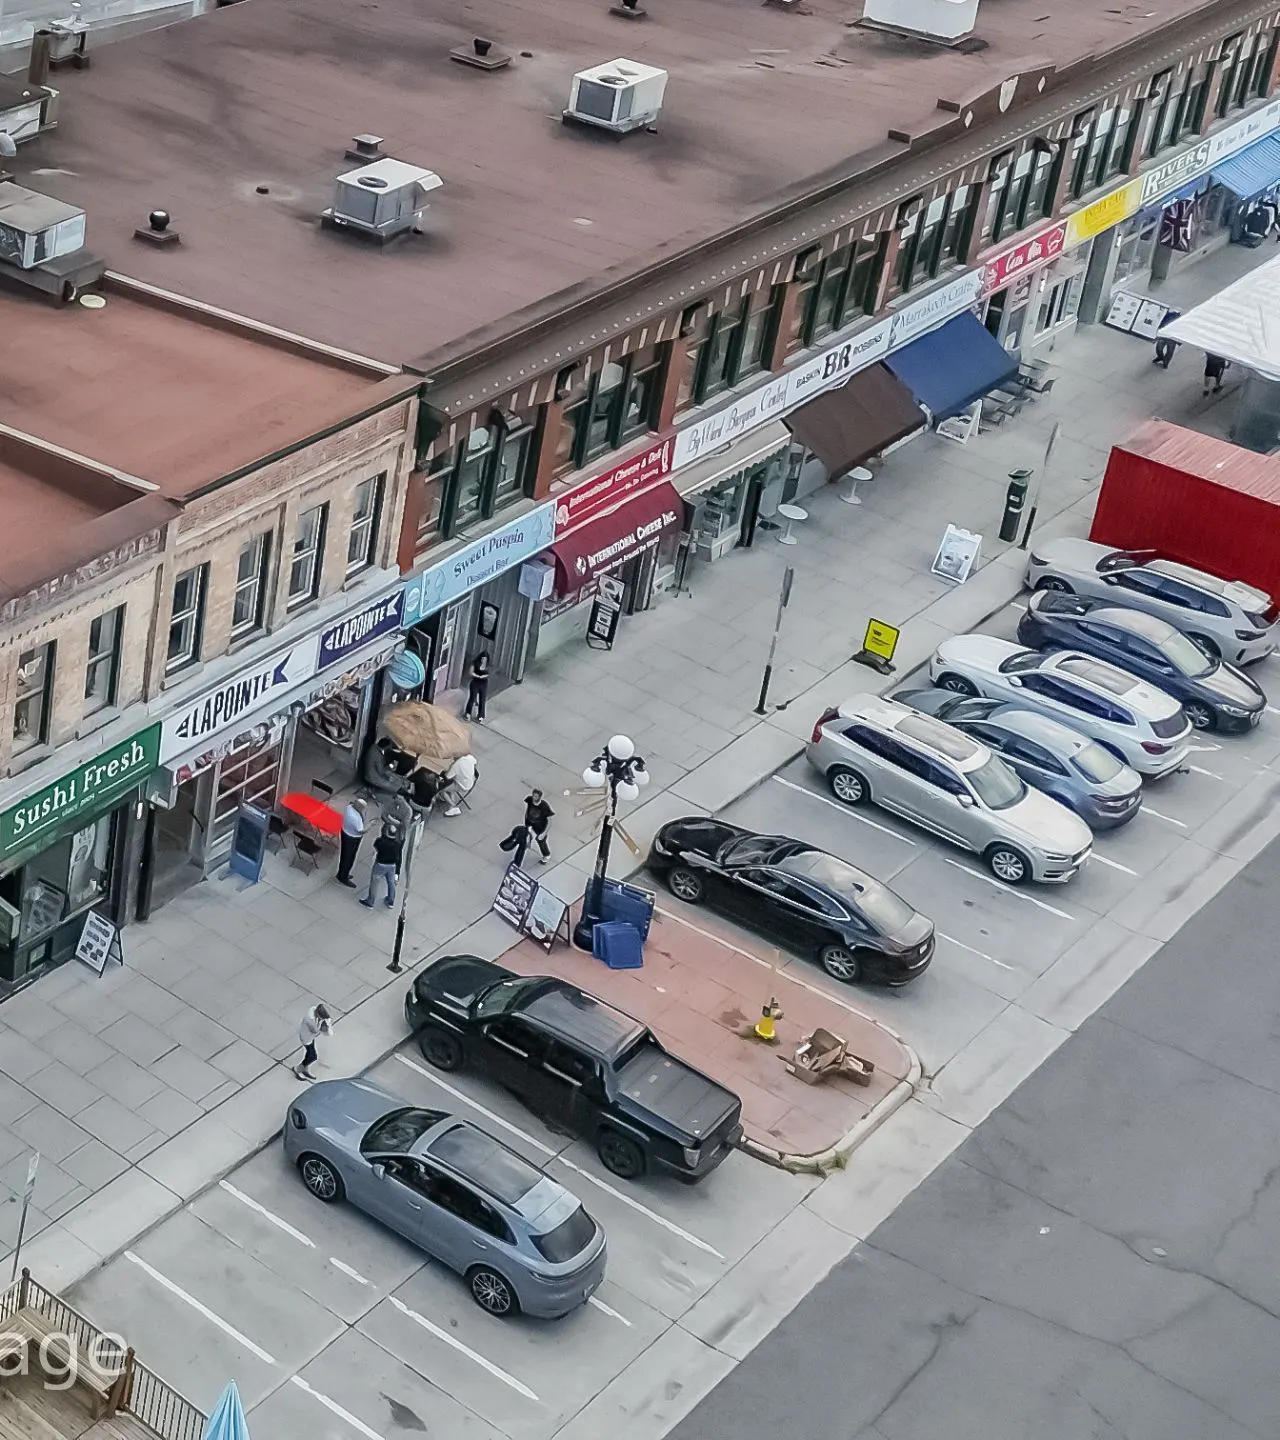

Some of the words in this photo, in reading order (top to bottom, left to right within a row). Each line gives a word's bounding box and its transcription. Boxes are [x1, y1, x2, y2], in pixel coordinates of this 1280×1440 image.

[1143, 143, 1210, 200] RIVERS
[796, 366, 821, 388] BASKIN
[822, 344, 851, 379] BR
[453, 546, 487, 578] Sweet
[334, 605, 386, 650] LAPOINTE
[191, 670, 272, 738] LAPOINTE
[13, 779, 76, 836] Sushi
[82, 740, 145, 793] Fresh
